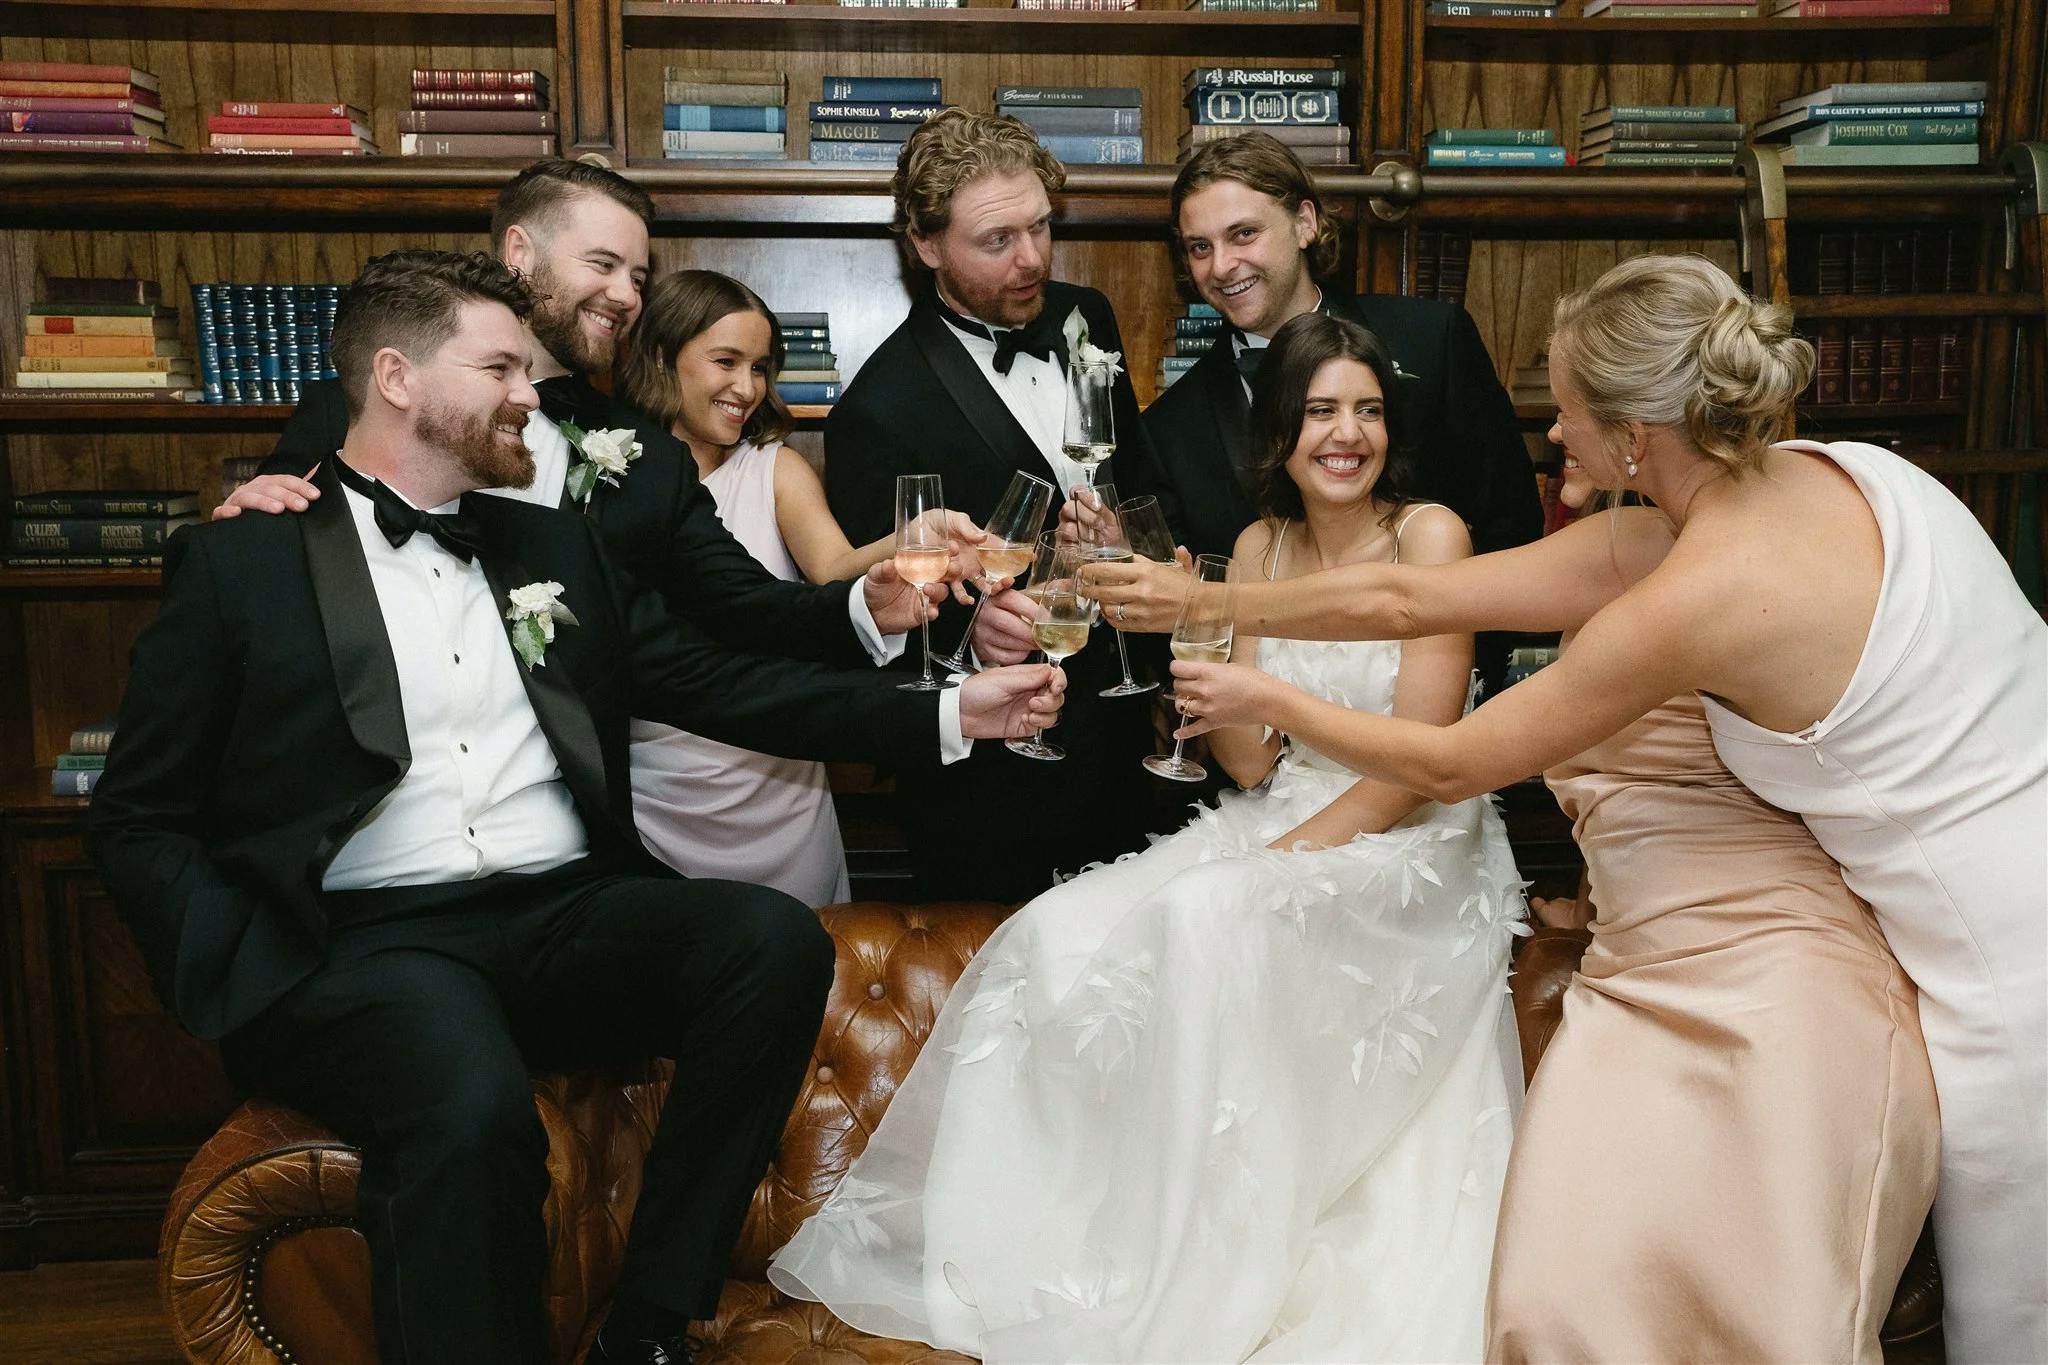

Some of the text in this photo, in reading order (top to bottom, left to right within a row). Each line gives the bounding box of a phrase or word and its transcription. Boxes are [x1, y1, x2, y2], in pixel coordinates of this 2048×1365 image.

[1514, 9, 1539, 17] LITTLE
[1234, 70, 1273, 85] Russia
[1273, 70, 1314, 85] House
[817, 106, 880, 117] SOPHIE KINSELLA
[1815, 107, 1829, 115] RON
[1867, 106, 1901, 114] COMPLETE
[1903, 106, 1921, 114] BOOK
[1933, 105, 1961, 113] FISHING
[821, 124, 880, 139] MAGGIE
[1835, 123, 1910, 139] JOSEPHINE COX
